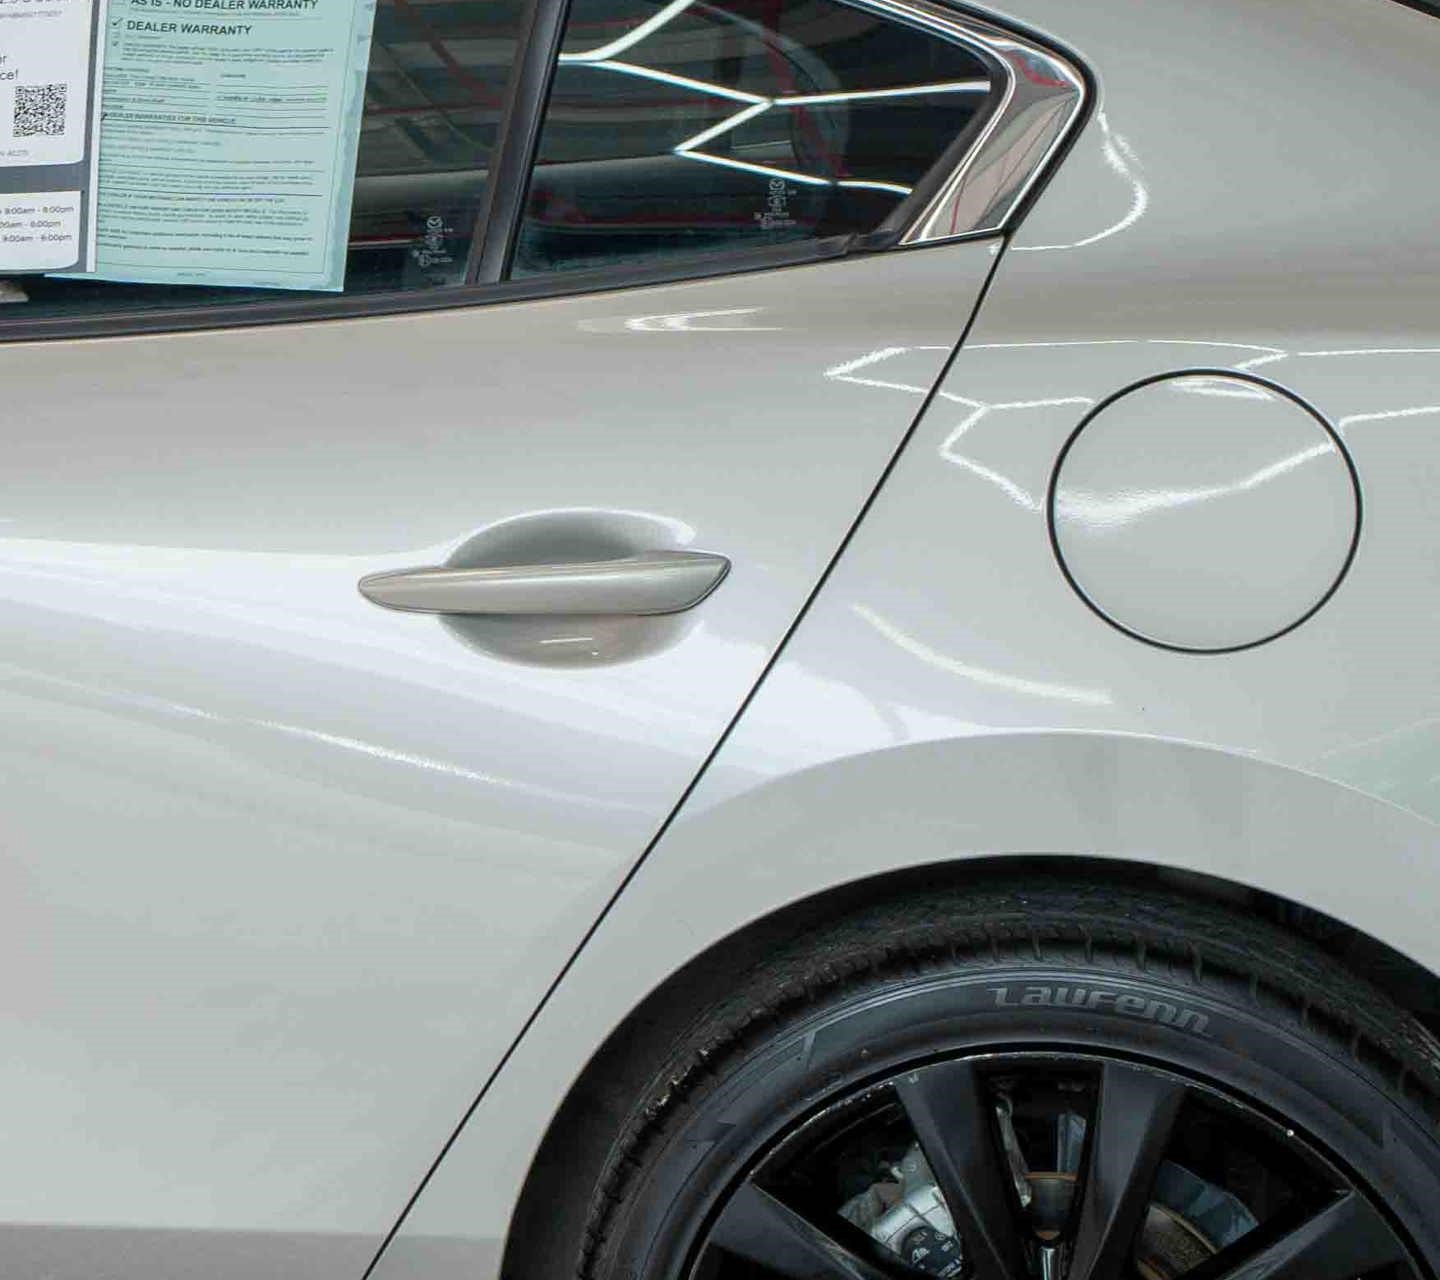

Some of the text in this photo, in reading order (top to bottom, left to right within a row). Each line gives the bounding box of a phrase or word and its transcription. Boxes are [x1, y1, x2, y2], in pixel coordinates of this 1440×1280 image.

[248, 0, 319, 10] WARRANTY
[127, 20, 253, 36] DEALER WARRANTY
